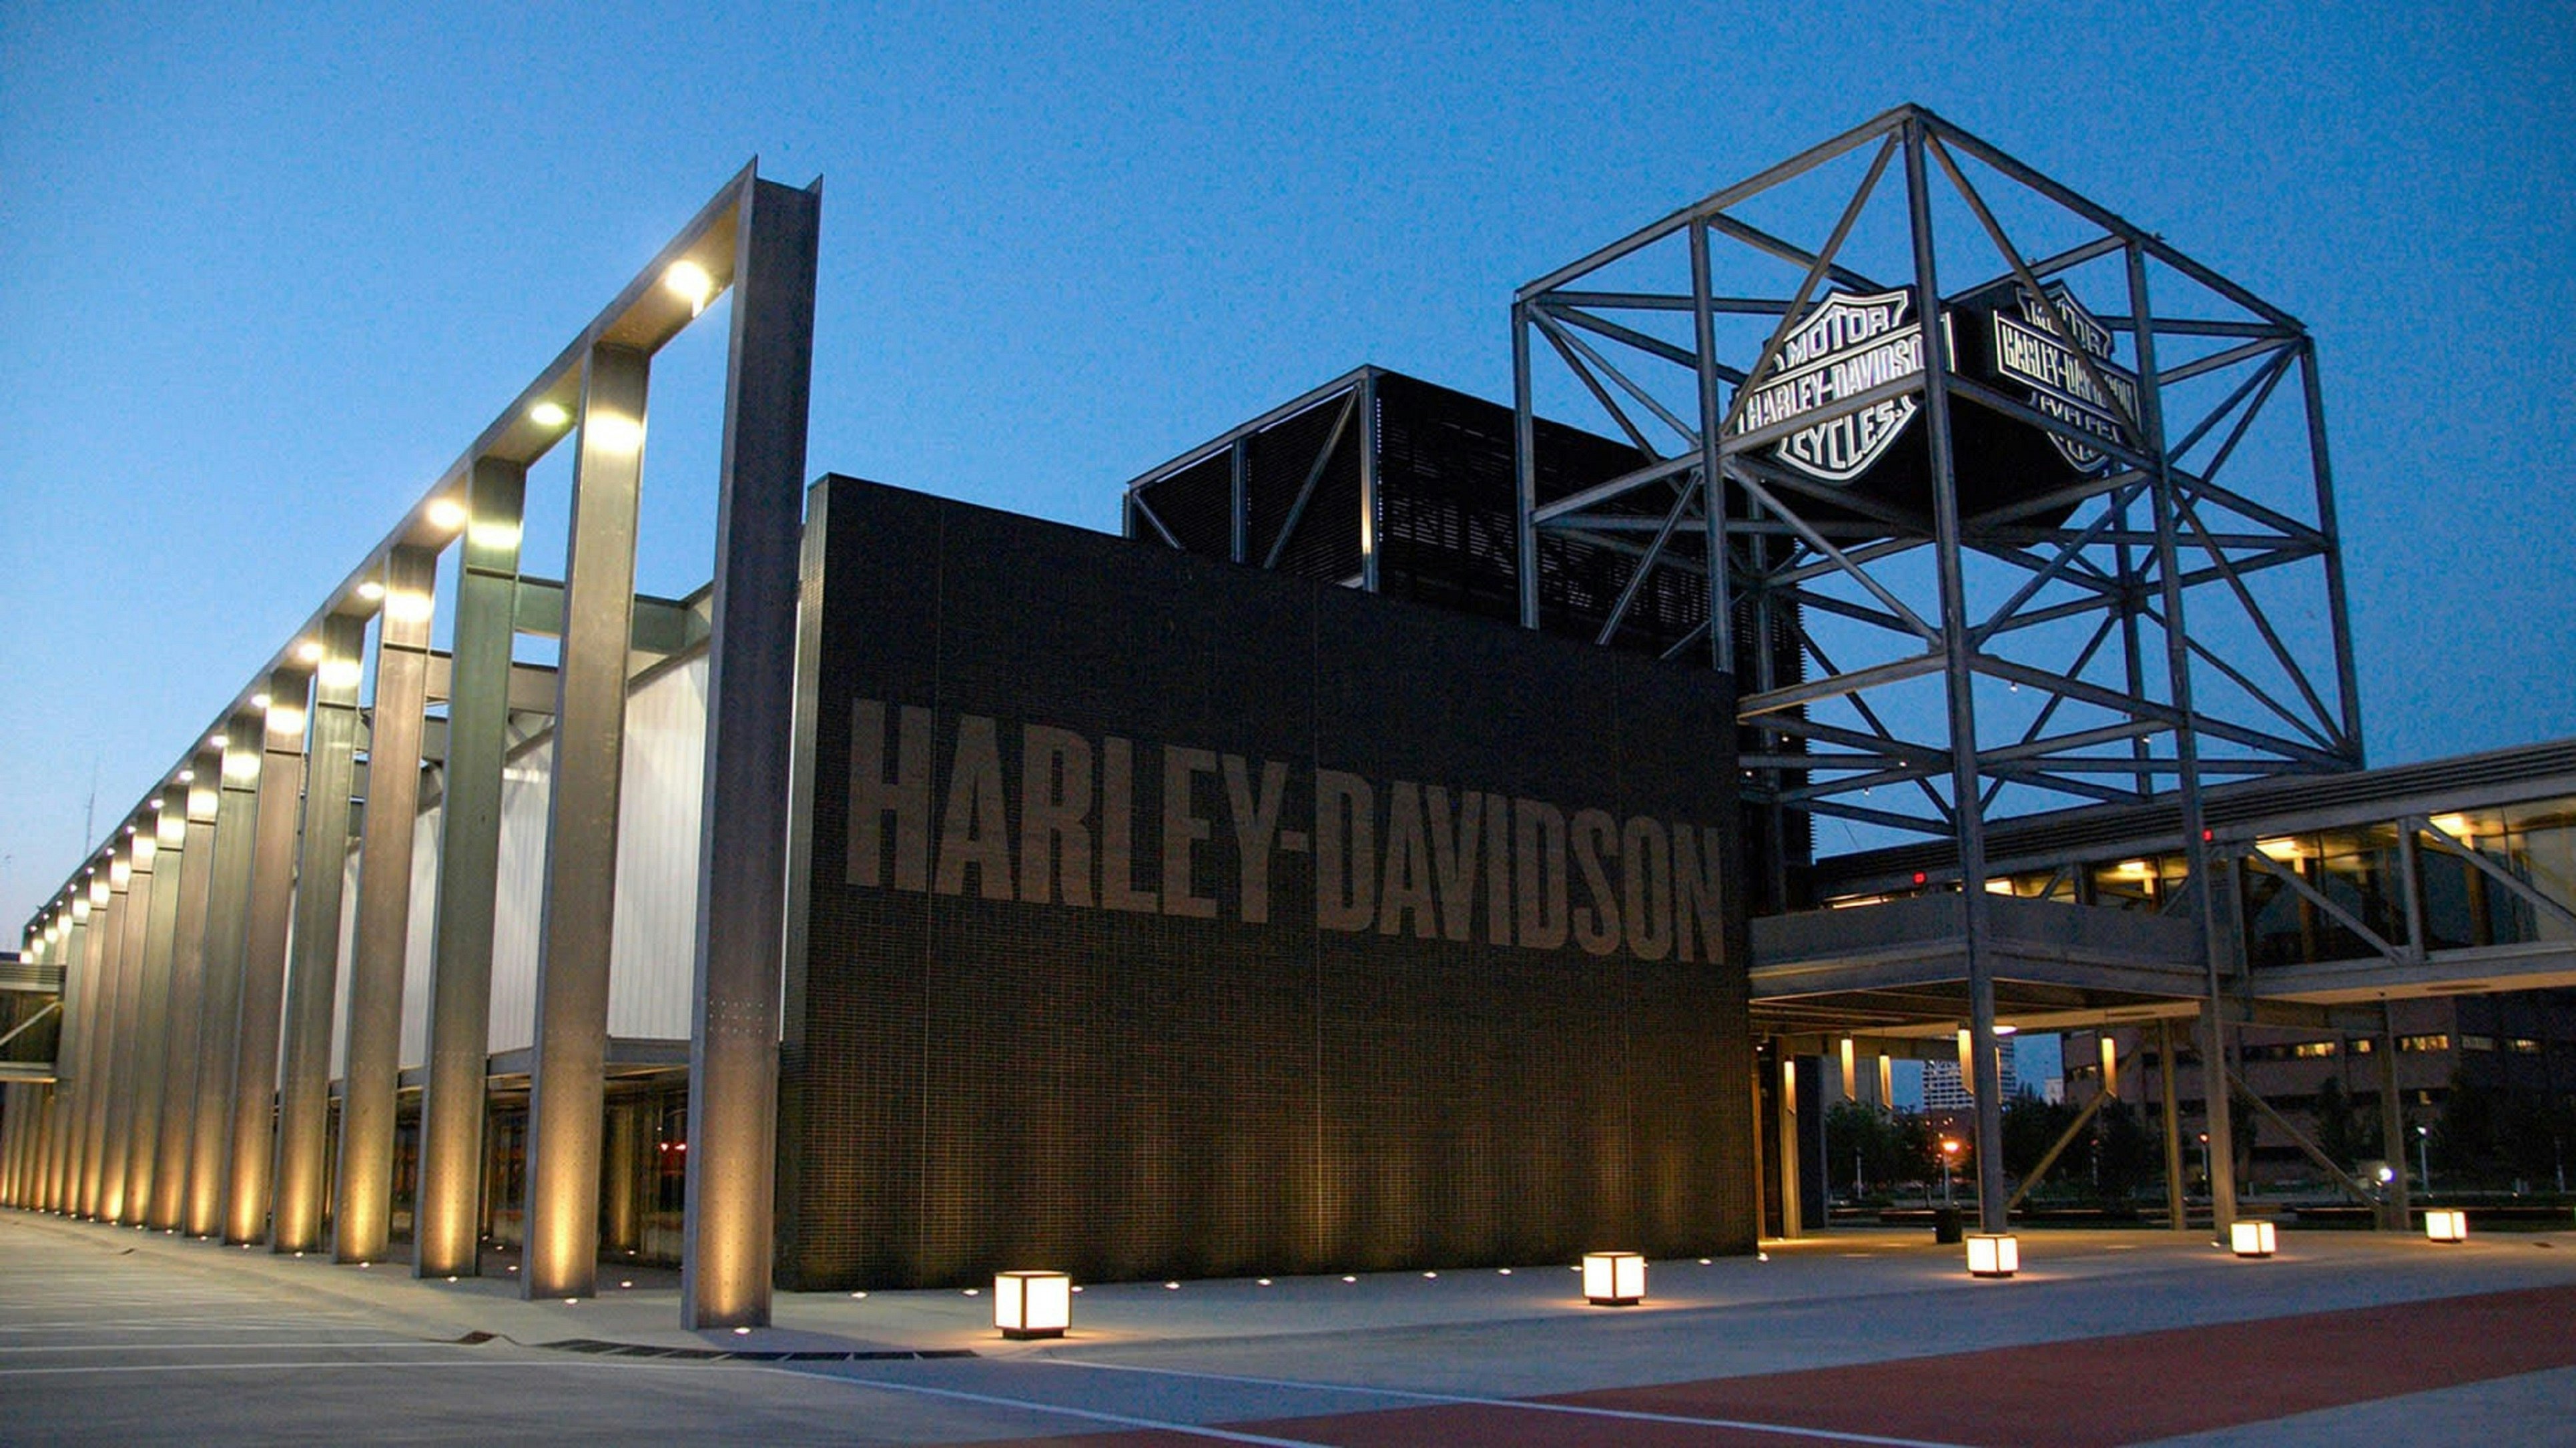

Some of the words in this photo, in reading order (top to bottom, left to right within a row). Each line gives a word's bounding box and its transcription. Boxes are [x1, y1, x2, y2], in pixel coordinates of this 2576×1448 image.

[1746, 334, 1925, 431] HARLEY-DAVIDSO
[1786, 305, 1890, 368] MOTOR
[2001, 324, 2135, 422] HARLEY-DAON
[1792, 398, 1895, 468] CYCLES
[846, 697, 1725, 966] HARLEY-DAVIDSON
